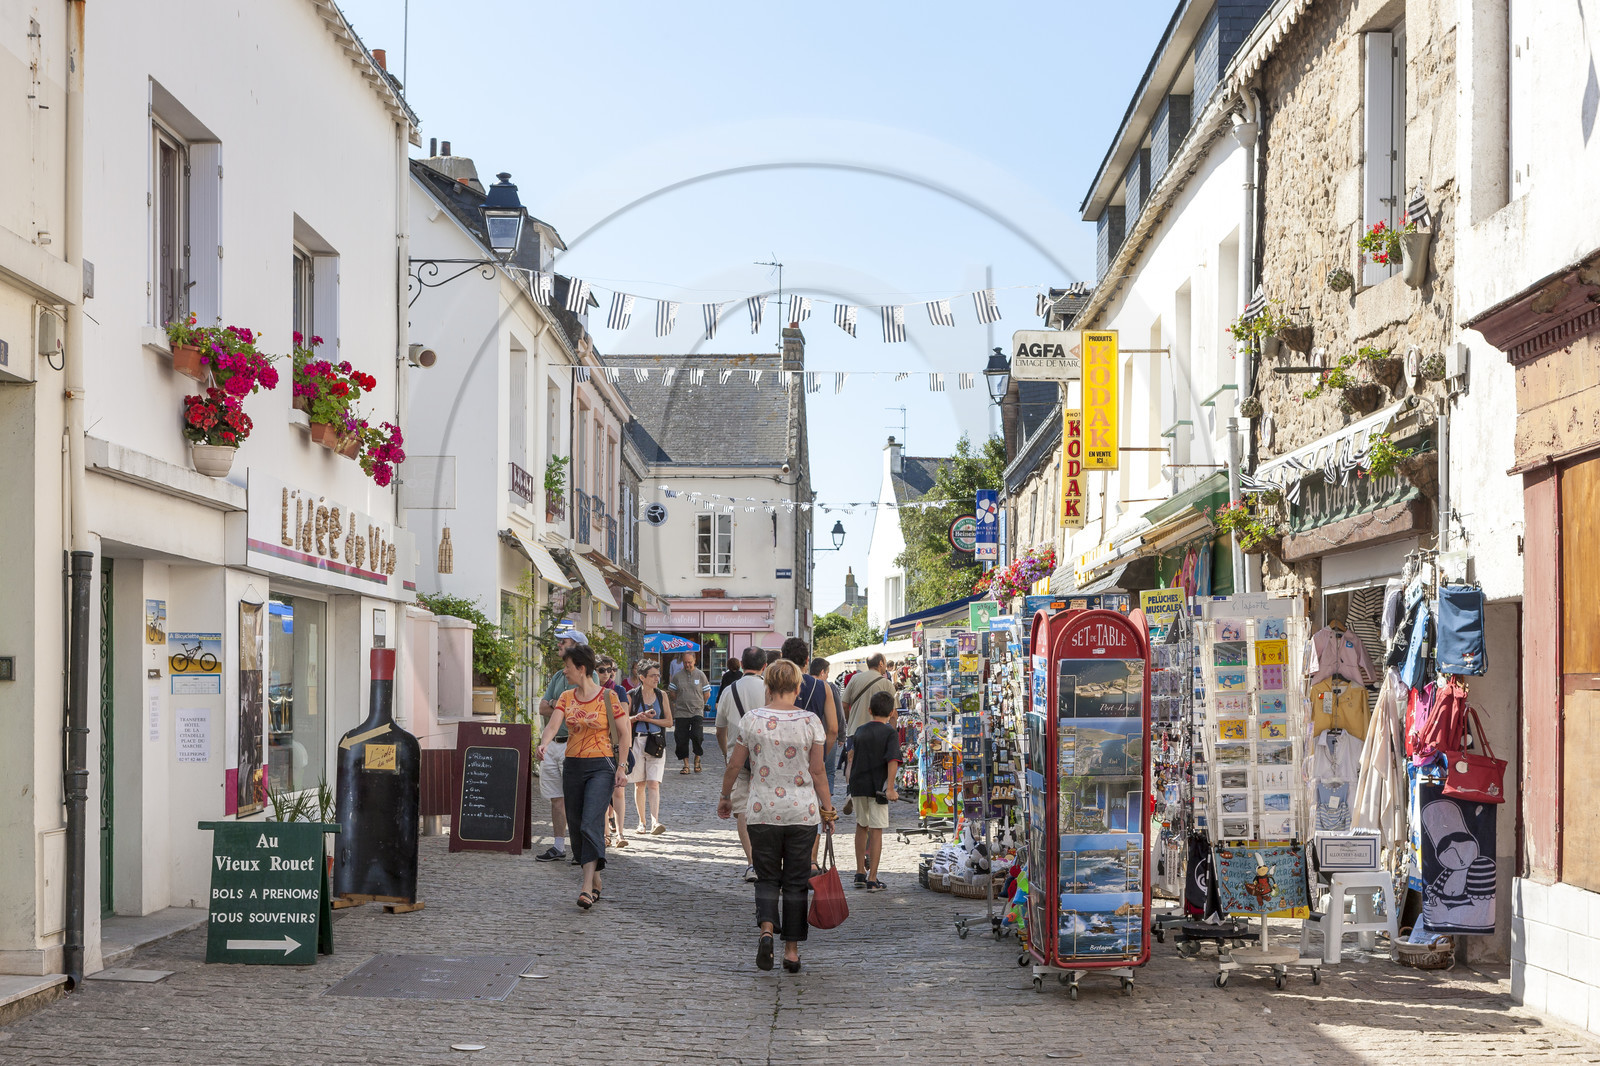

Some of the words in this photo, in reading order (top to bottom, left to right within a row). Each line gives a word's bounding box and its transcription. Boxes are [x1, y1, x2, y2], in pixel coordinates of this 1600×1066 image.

[1016, 343, 1066, 357] AGFA
[1089, 345, 1110, 447] KODAK
[1065, 420, 1081, 516] KODAK
[1148, 594, 1178, 604] PELUCHES
[1146, 604, 1180, 614] MUSICALE
[1072, 625, 1091, 646] SET
[1096, 624, 1127, 646] TABLE
[481, 727, 506, 736] VINS
[256, 833, 278, 848] Au
[215, 855, 260, 871] Vieux
[270, 856, 314, 871] Rouet
[212, 889, 244, 899] BOLS
[249, 889, 257, 899] A
[263, 889, 319, 900] PRENOMS
[211, 913, 243, 923] TOUS
[249, 913, 316, 923] SOUVENIRS
